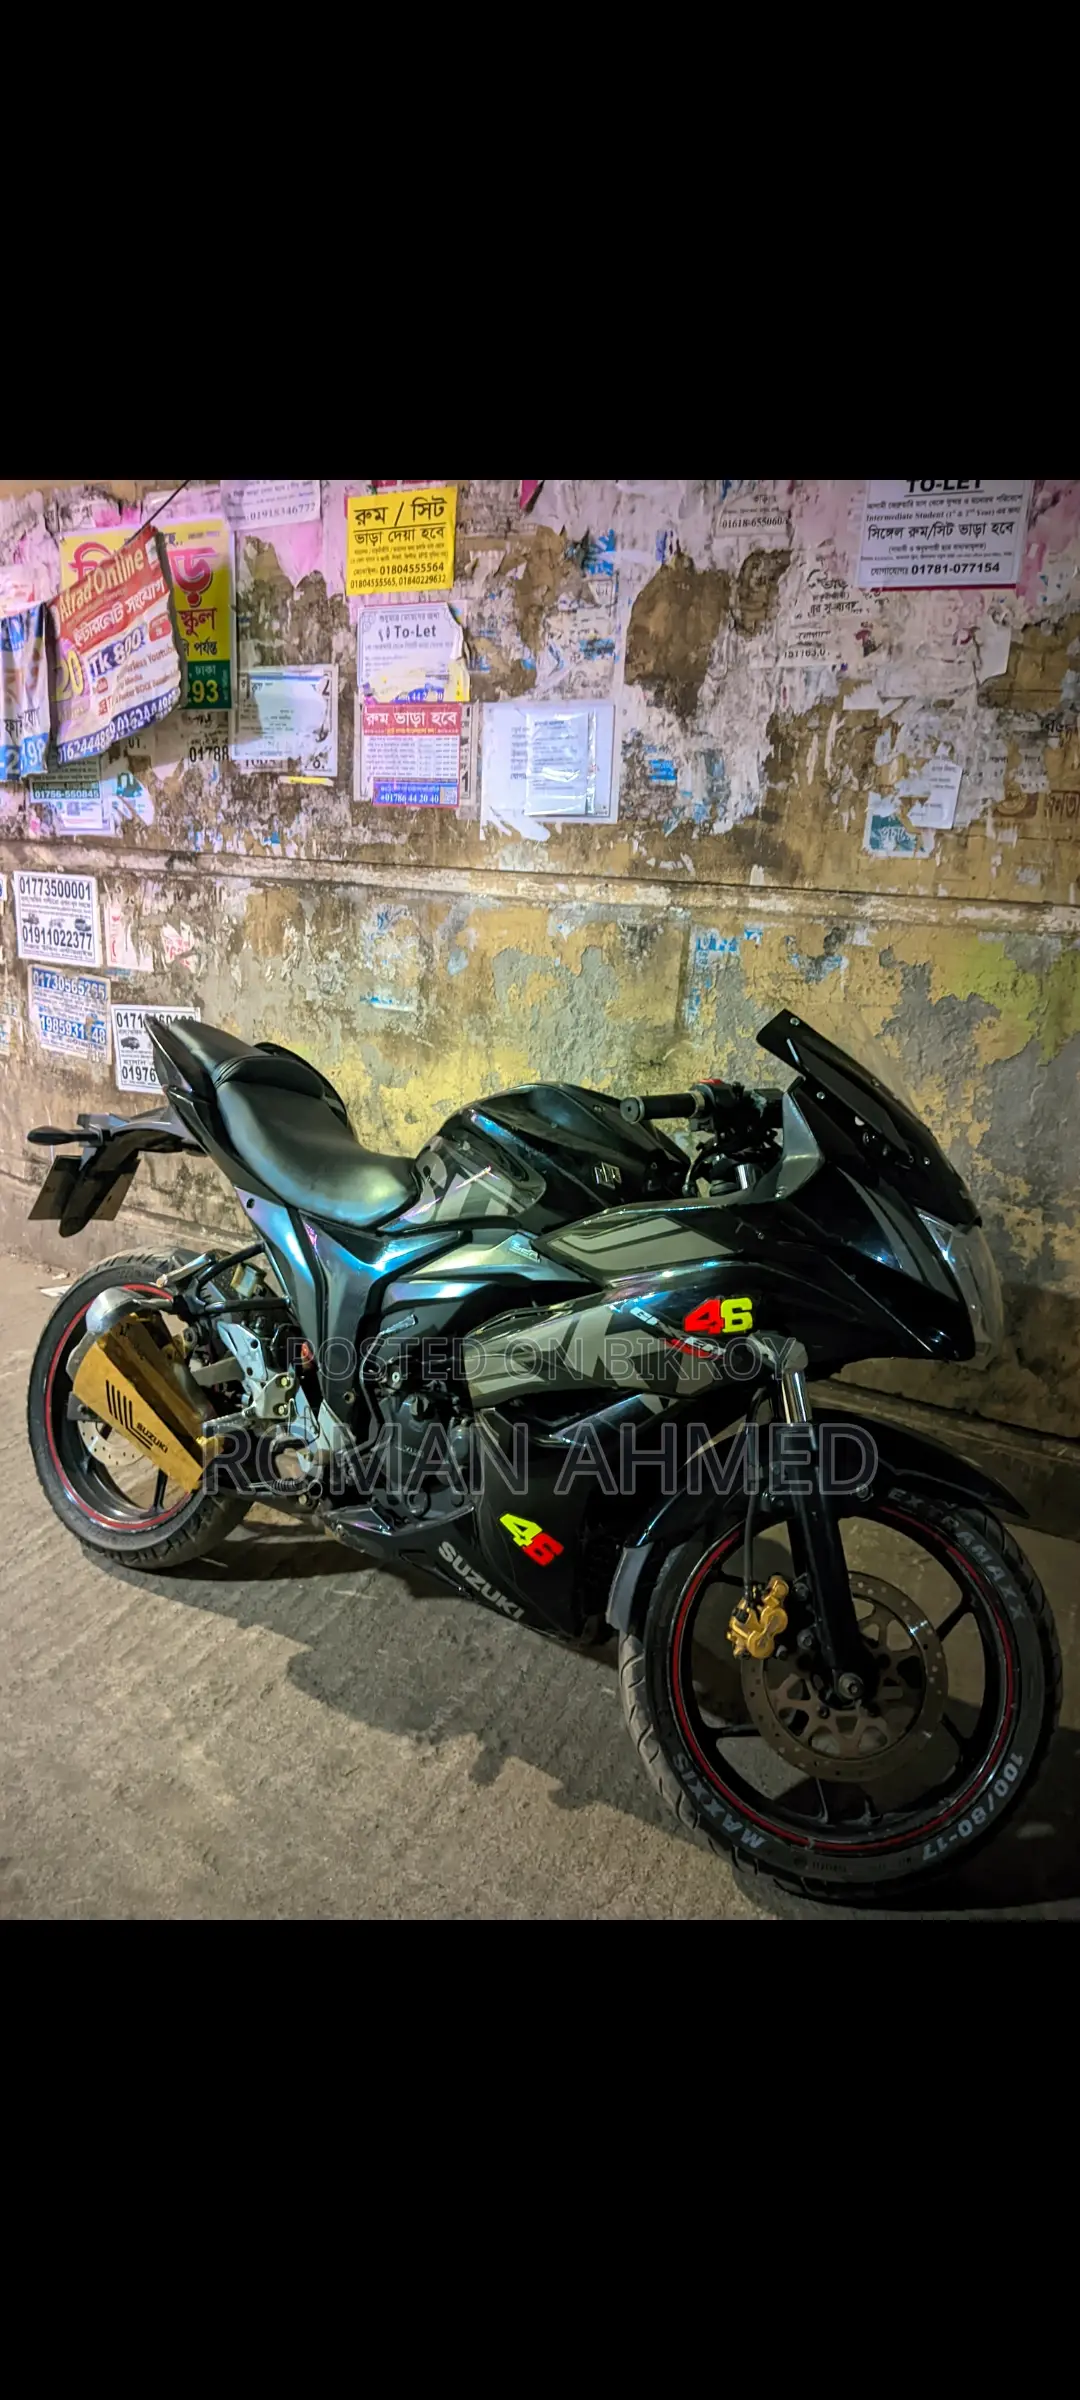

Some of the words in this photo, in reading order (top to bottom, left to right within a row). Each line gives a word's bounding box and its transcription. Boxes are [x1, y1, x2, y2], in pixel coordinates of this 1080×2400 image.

[907, 480, 982, 493] TO-LET
[354, 507, 389, 527] রুম
[394, 501, 405, 527] /
[410, 495, 448, 523] সিট
[866, 512, 913, 522] Intermediate
[915, 511, 944, 520] Student
[354, 530, 383, 546] ভাড়া
[388, 528, 416, 543] দেয়া
[421, 526, 446, 541] হবে
[868, 524, 904, 541] সিঙ্গেল
[908, 521, 955, 541] রুম/সিট
[959, 521, 987, 539] ভাড়া
[991, 520, 1015, 536] হবে
[93, 549, 145, 595] Online
[380, 562, 445, 576] 01804555564
[911, 562, 1000, 576] 01781-077154
[350, 577, 398, 590] 01804555565,
[177, 607, 218, 637] স্কুল
[394, 624, 437, 640] To-Let
[366, 712, 390, 726] রুম
[393, 711, 426, 728] ভাড়া
[431, 711, 458, 727] হবে
[19, 876, 92, 900] 01773500001
[22, 926, 93, 950] 01911022377
[40, 1015, 107, 1044] 198593148
[683, 1297, 754, 1335] 46
[136, 1422, 169, 1454] SUZUKI
[499, 1513, 565, 1567] 46
[438, 1541, 525, 1620] SUZUKI
[672, 1753, 767, 1849] MAXXIS
[922, 1752, 1024, 1861] 100/80-17
